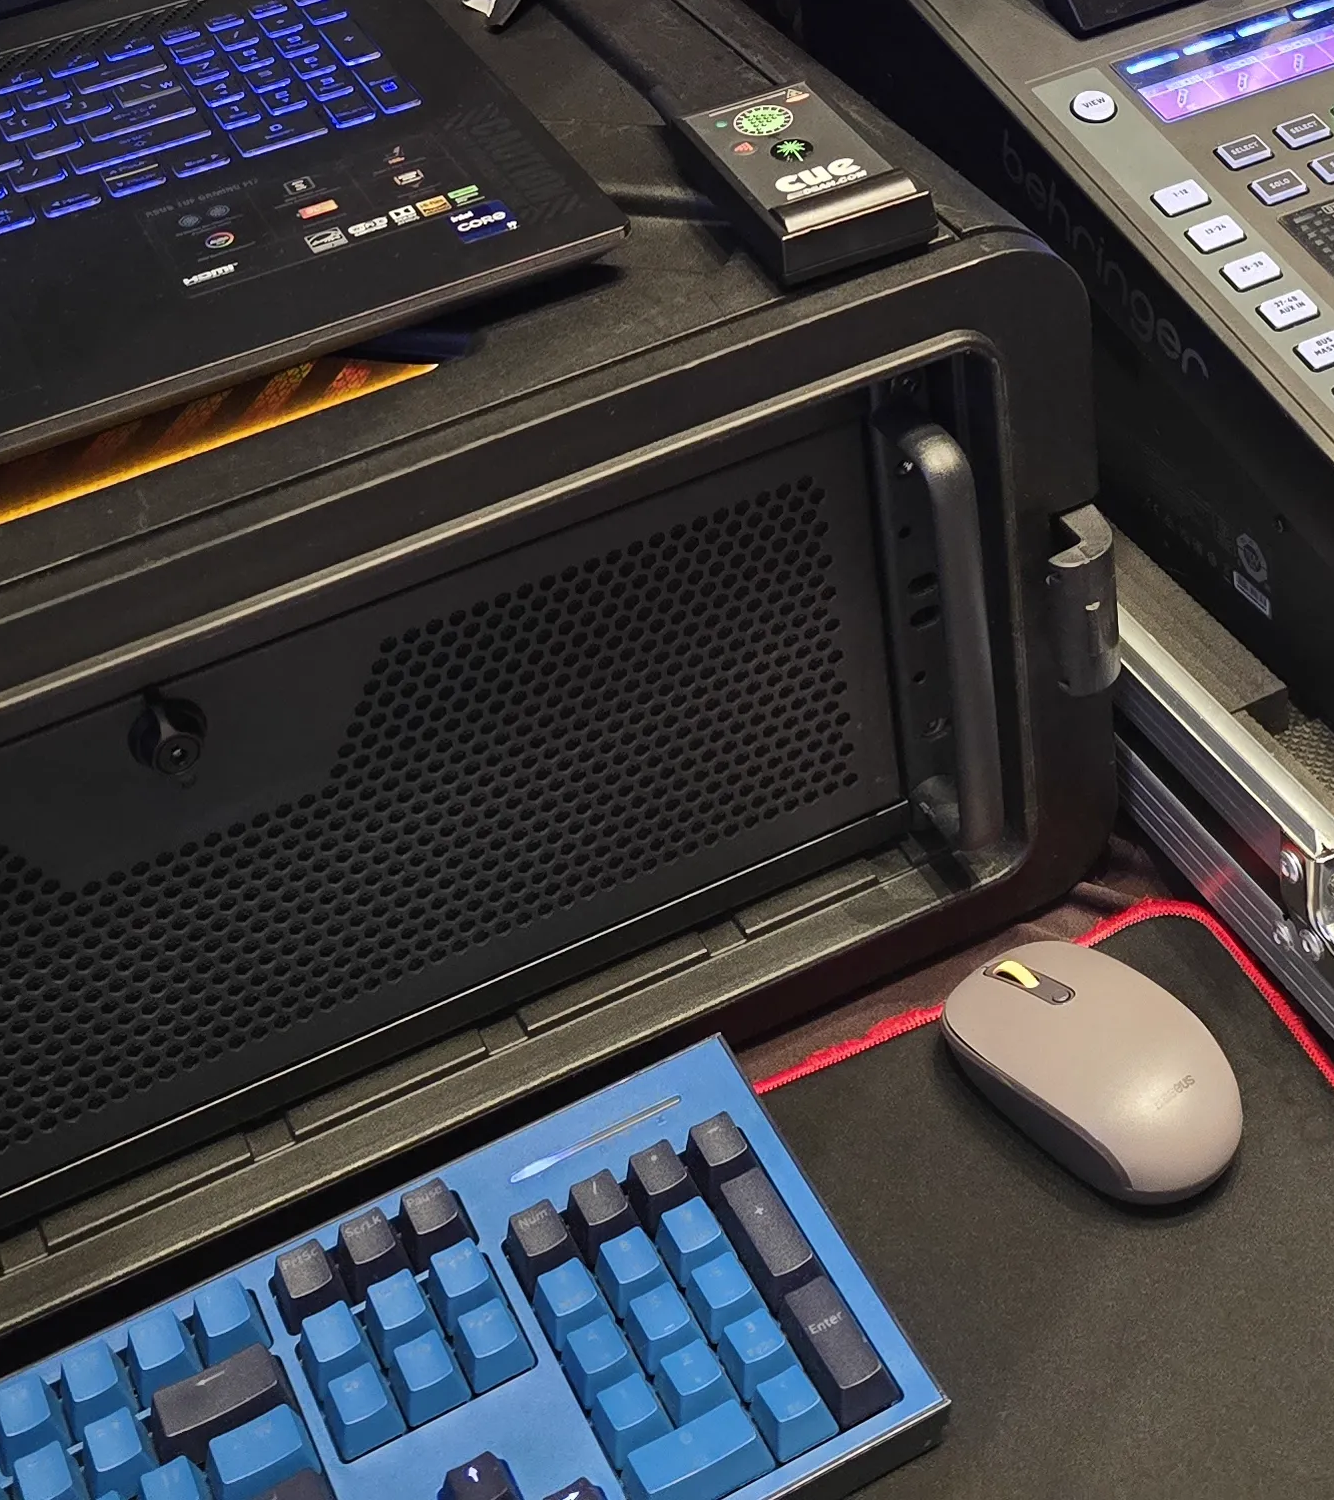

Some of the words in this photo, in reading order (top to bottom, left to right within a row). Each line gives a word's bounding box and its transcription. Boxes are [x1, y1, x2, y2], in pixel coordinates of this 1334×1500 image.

[1082, 96, 1106, 110] VIEW
[1289, 120, 1317, 135] SELECT
[1231, 141, 1259, 155] SELECT
[1269, 177, 1291, 189] SOLO
[1273, 296, 1298, 308] 37-48
[1279, 305, 1296, 315] AUX
[1296, 301, 1306, 310] IN
[1316, 336, 1333, 347] BUS
[406, 1185, 443, 1208] Pause
[518, 1208, 548, 1228] Num
[344, 1215, 382, 1238] ScrLk
[808, 1310, 845, 1336] Enter
